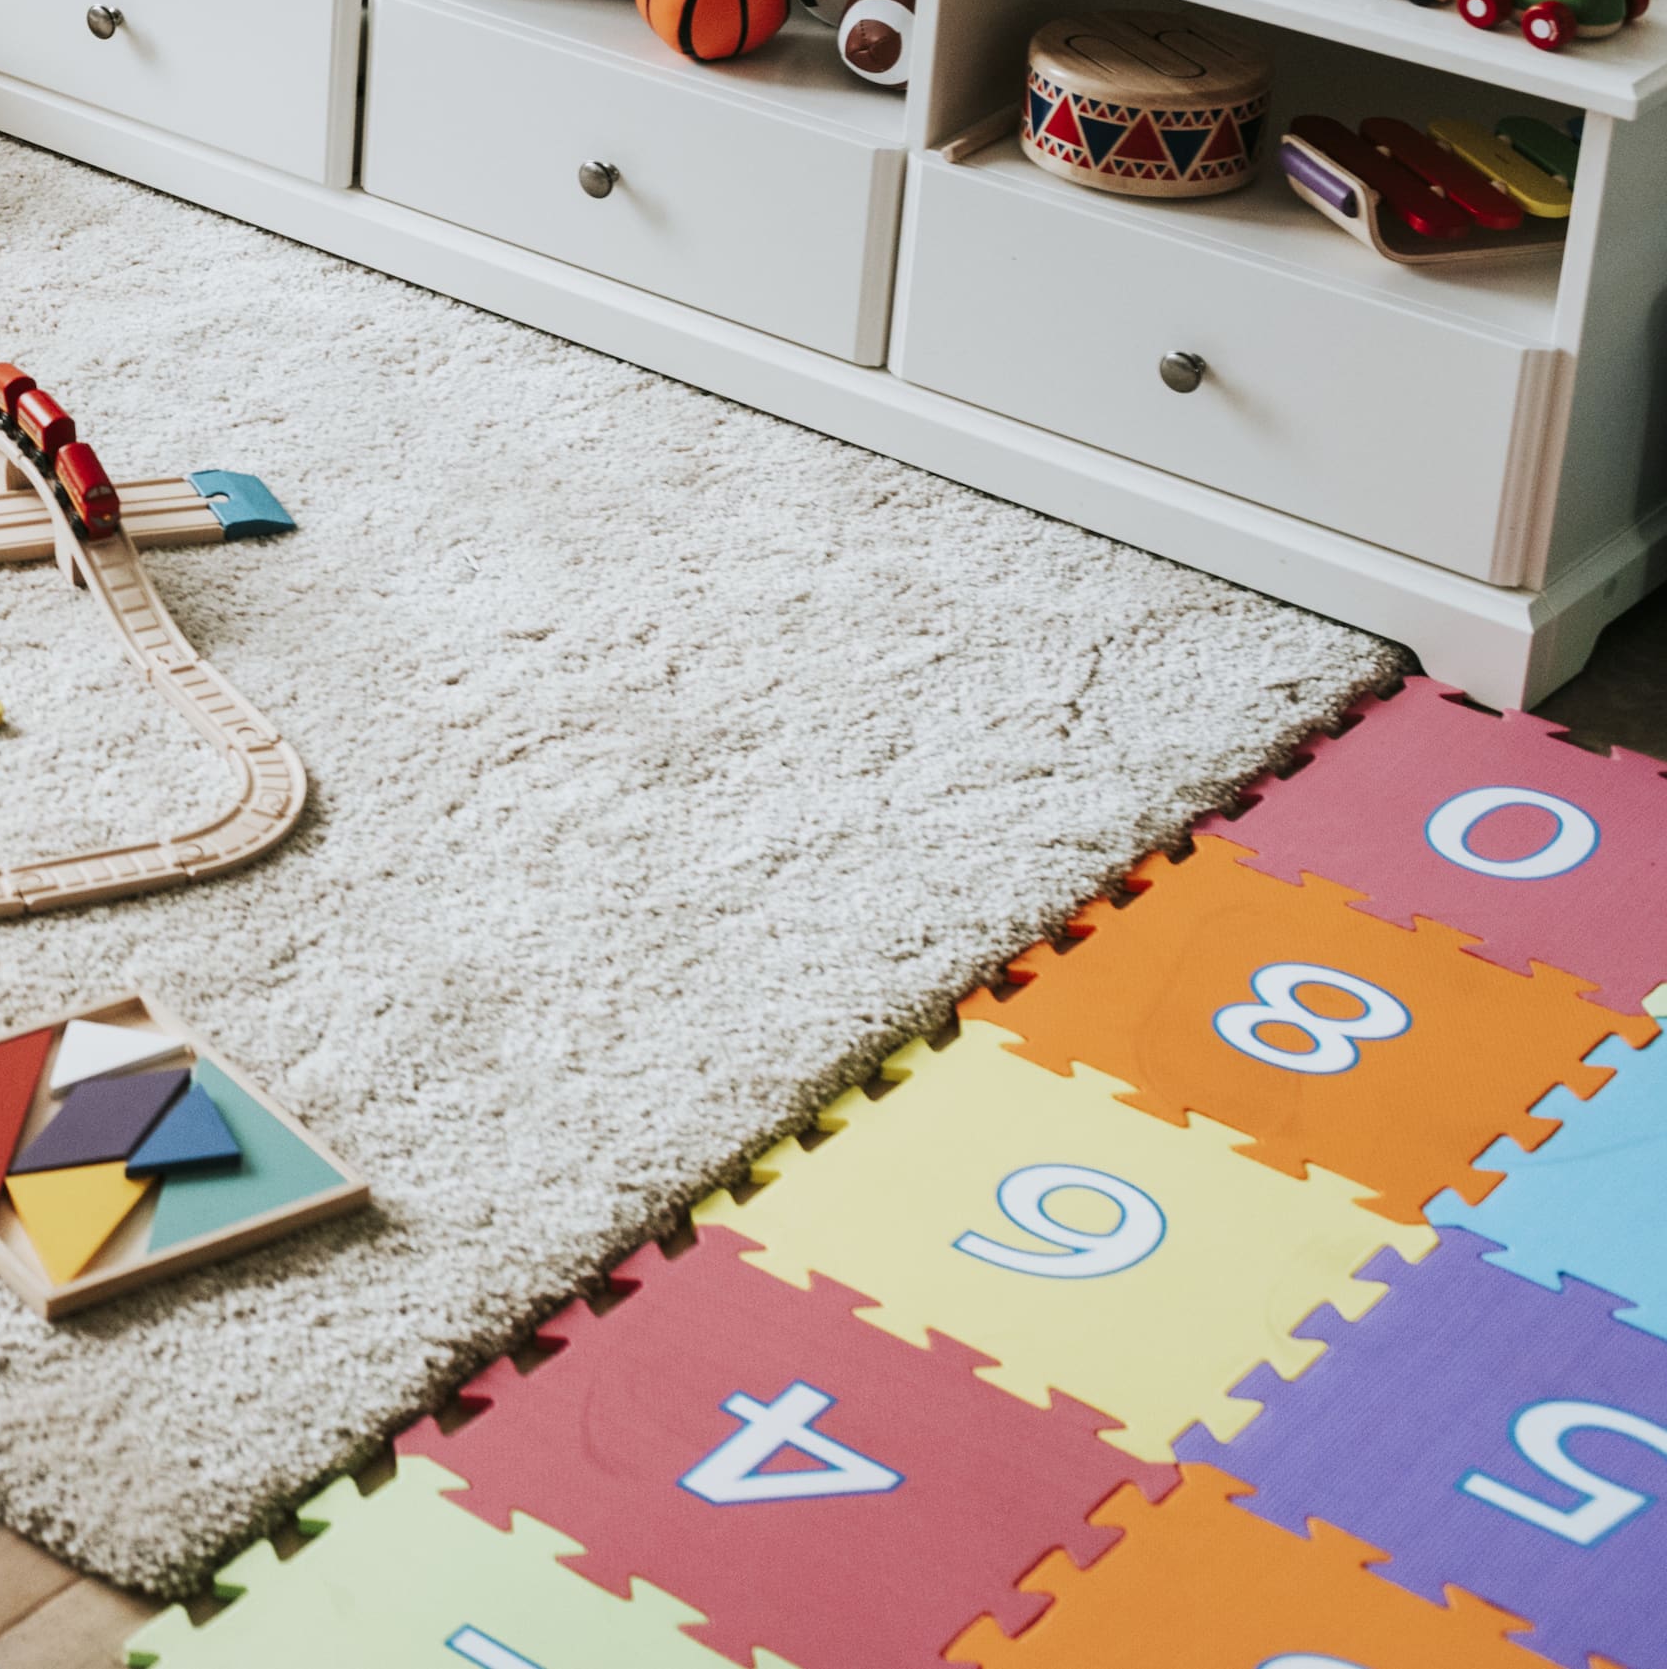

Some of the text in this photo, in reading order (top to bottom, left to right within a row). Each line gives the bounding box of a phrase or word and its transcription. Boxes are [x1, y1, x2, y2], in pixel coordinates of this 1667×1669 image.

[1210, 960, 1414, 1077] 8
[677, 1378, 907, 1508] 4
[1452, 1395, 1667, 1551] 5
